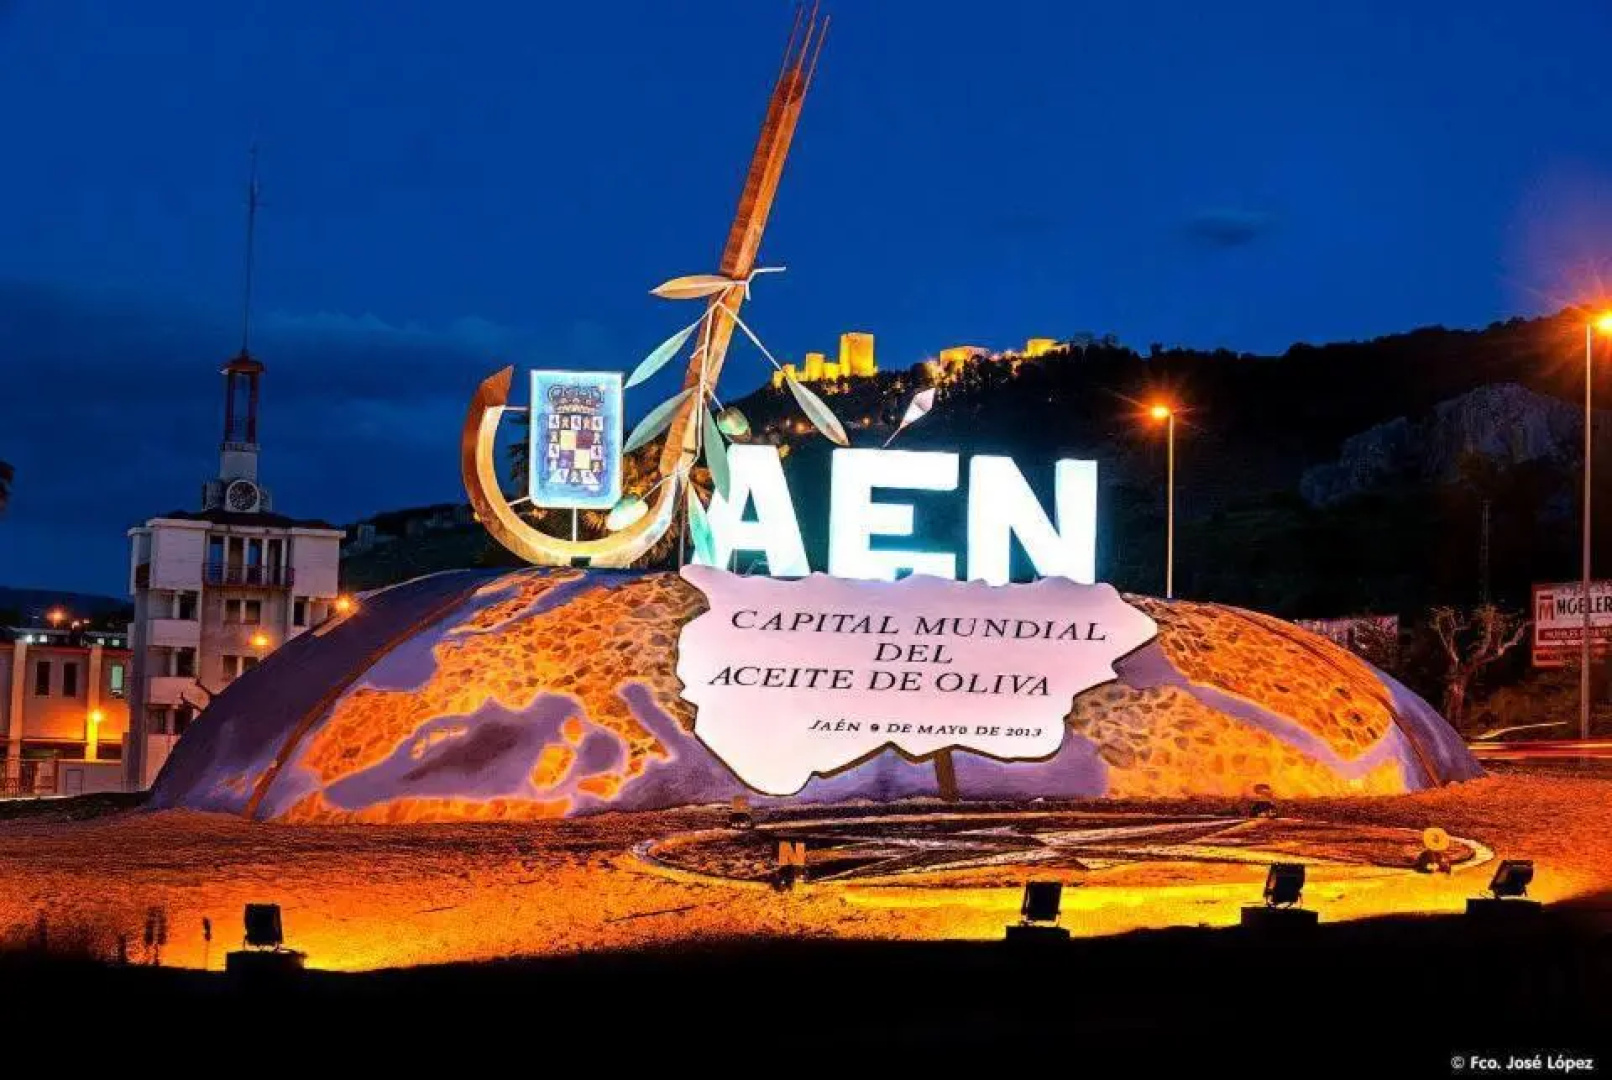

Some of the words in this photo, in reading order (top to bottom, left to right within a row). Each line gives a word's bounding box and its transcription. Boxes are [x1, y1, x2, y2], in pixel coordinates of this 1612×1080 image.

[732, 610, 900, 635] CAPITAL
[914, 616, 1107, 642] MUNDIAL
[874, 643, 953, 664] DEL
[707, 665, 854, 690] ACEITE
[866, 670, 923, 692] DE
[934, 672, 1050, 697] OLIVA
[808, 718, 861, 732] JAÉN
[886, 723, 913, 734] DE
[917, 724, 968, 735] MAYO
[974, 725, 1001, 737] DE
[1005, 727, 1043, 738] 2013
[778, 841, 806, 866] N
